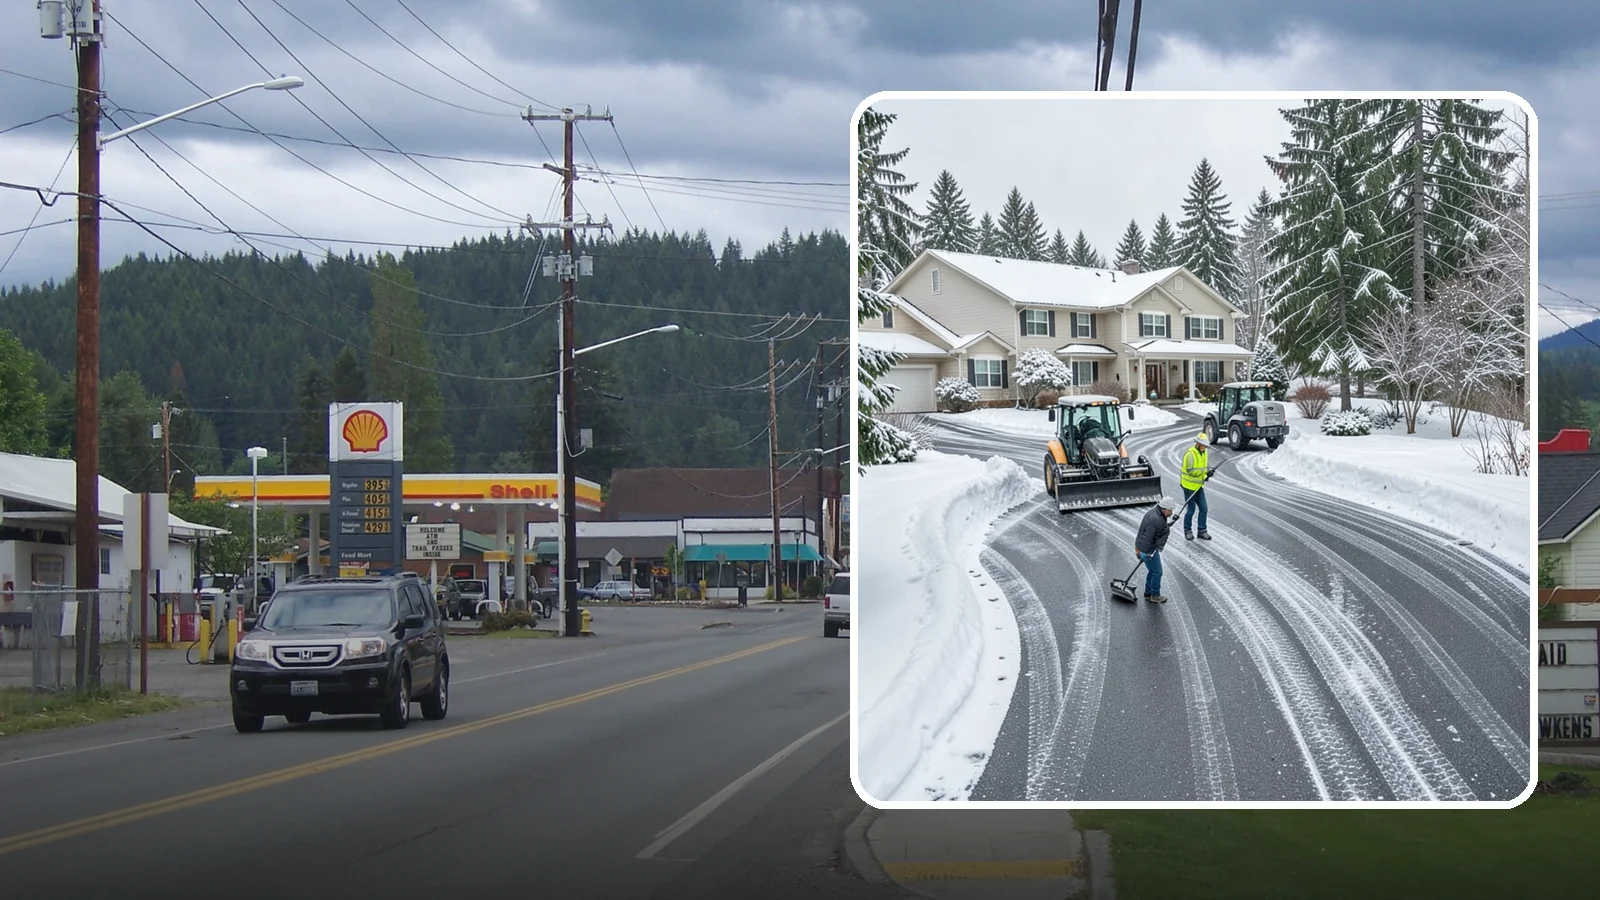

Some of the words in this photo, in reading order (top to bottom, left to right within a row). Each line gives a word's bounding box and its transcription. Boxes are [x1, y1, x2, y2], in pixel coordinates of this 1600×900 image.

[342, 482, 358, 490] Regular
[366, 480, 383, 490] 395
[490, 484, 547, 499] Shell
[366, 494, 383, 504] 405
[366, 508, 383, 518] 415
[366, 522, 383, 532] 429
[1539, 643, 1567, 665] AID
